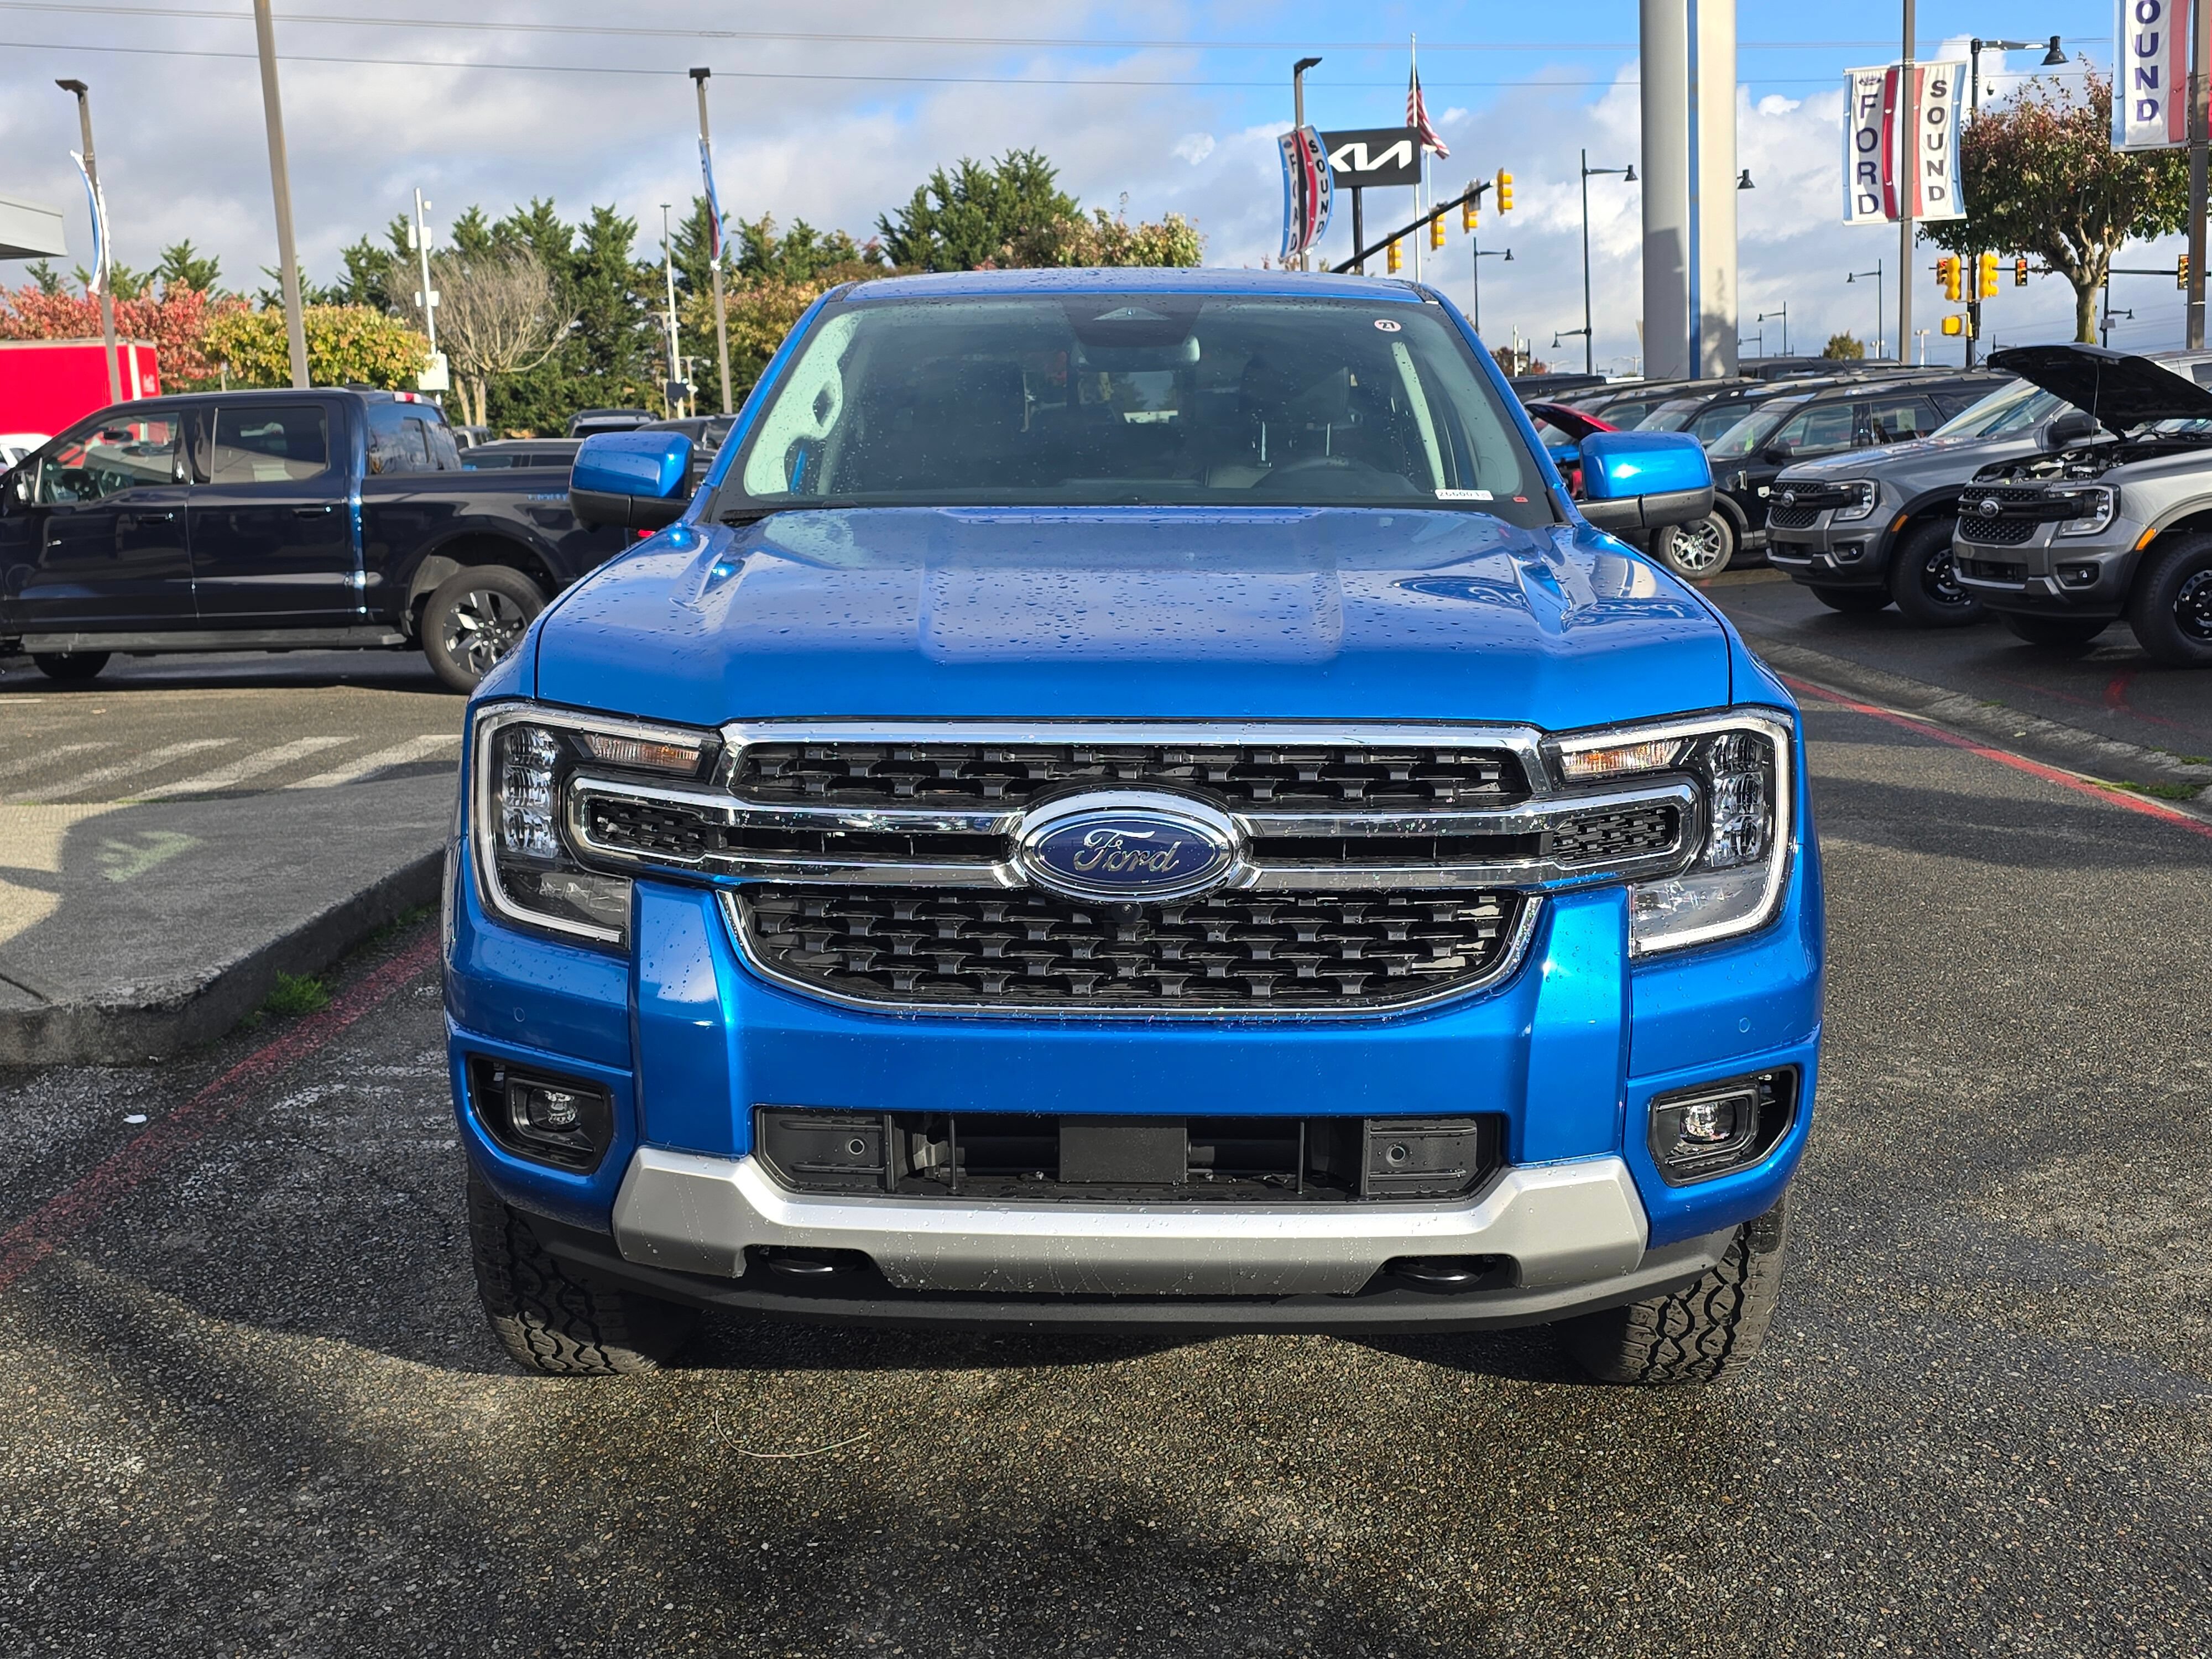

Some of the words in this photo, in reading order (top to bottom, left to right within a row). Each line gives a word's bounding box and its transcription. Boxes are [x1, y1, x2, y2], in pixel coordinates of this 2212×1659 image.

[1308, 139, 1329, 234] SOUND
[1327, 140, 1412, 173] KIA
[1856, 93, 1879, 215] FORD
[1926, 80, 1947, 202] SOUND
[1073, 828, 1182, 873] Ford
